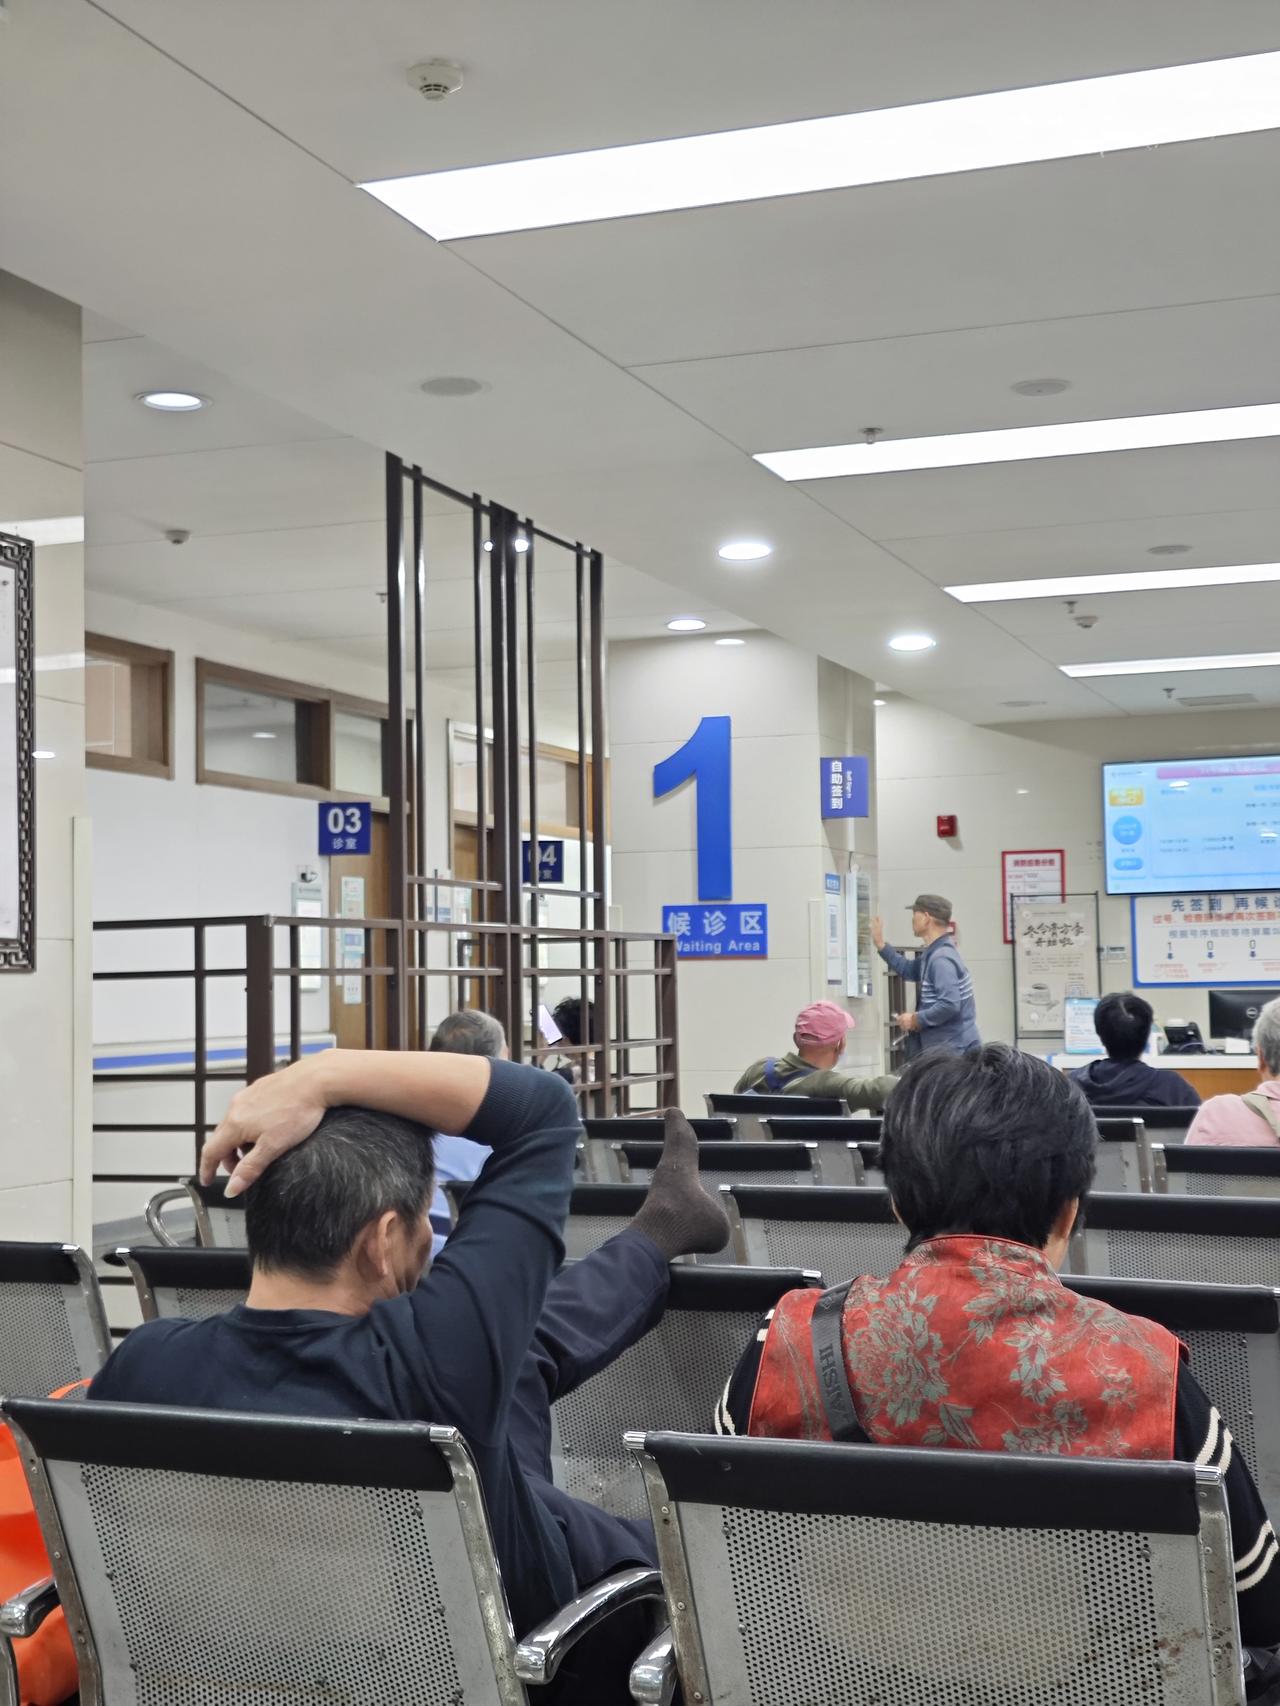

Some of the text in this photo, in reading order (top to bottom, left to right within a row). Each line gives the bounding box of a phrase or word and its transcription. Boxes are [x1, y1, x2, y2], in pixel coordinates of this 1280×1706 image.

[831, 760, 843, 810] 自助签到
[328, 807, 362, 834] 03
[653, 716, 732, 902] 1
[333, 838, 357, 850] 诊室
[1171, 897, 1222, 912] 先签到
[668, 911, 764, 936] 候诊区
[728, 940, 760, 952] Area
